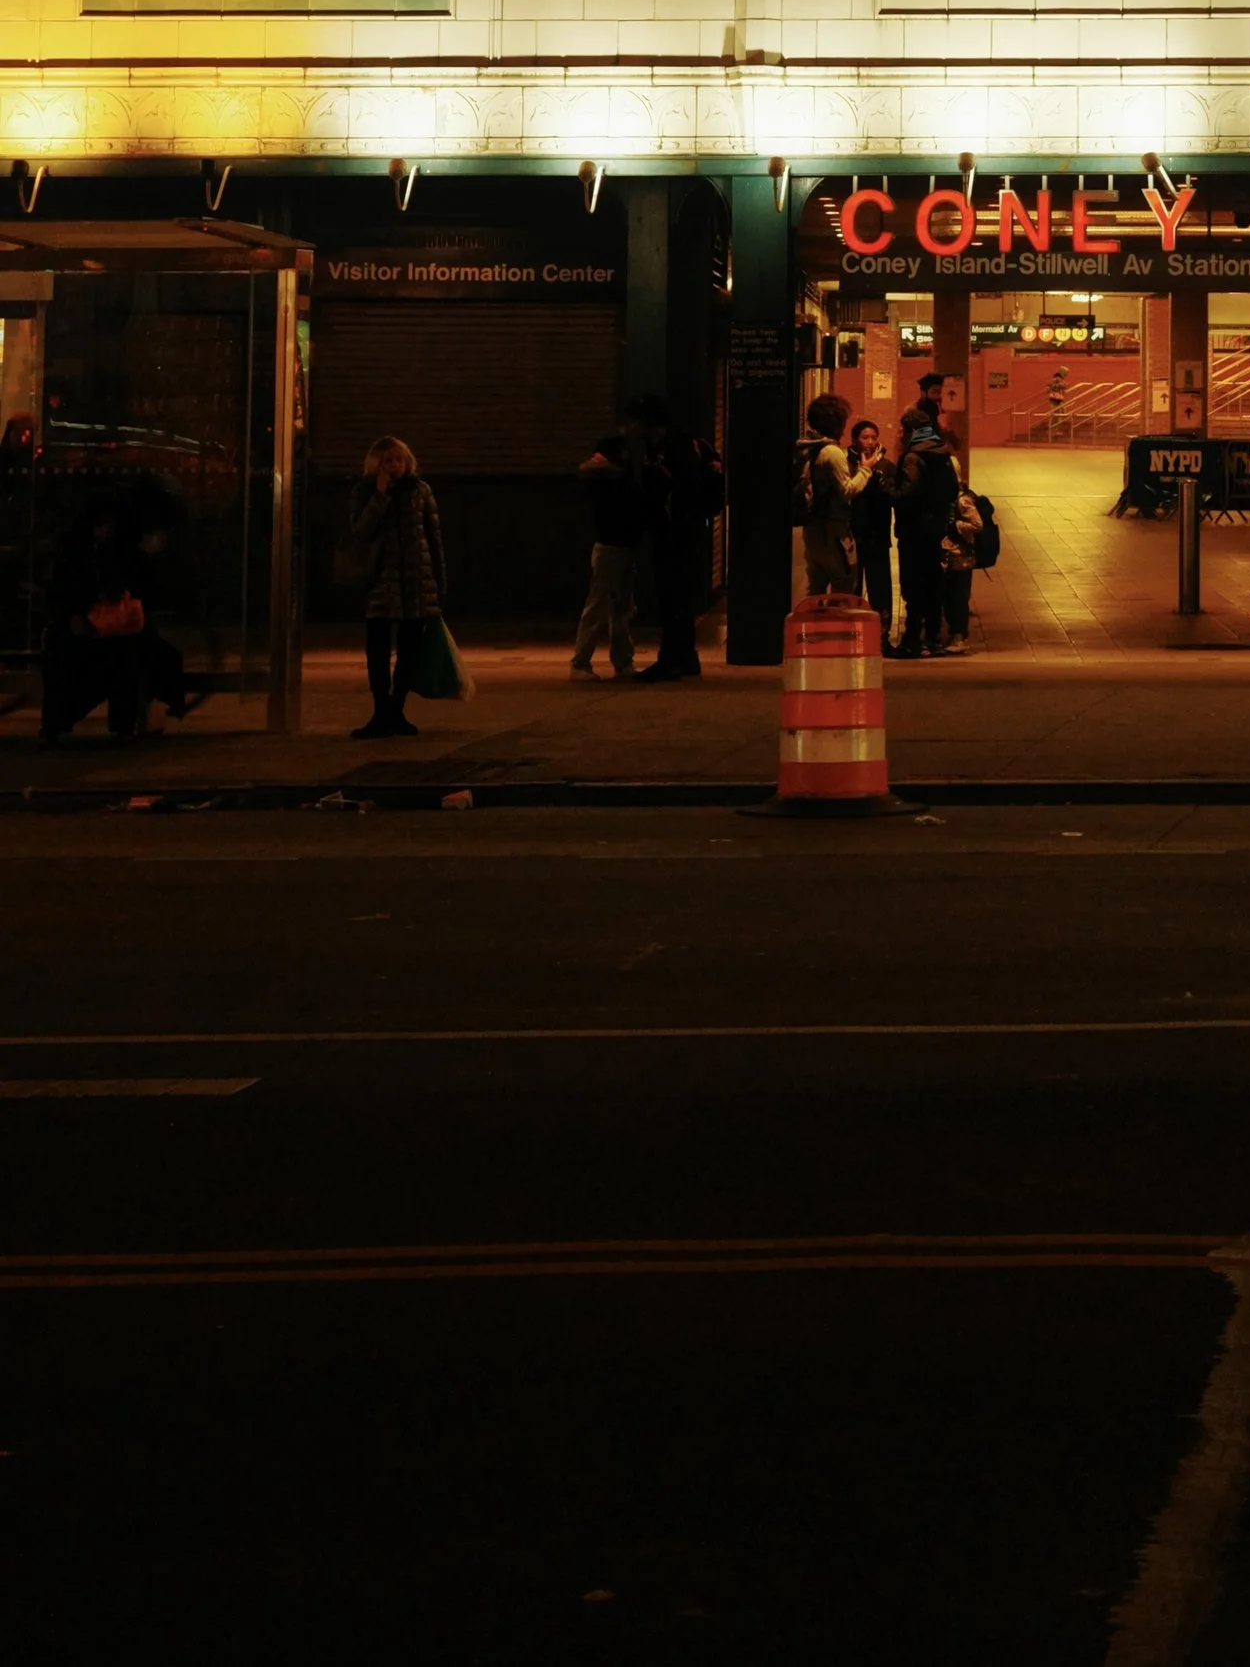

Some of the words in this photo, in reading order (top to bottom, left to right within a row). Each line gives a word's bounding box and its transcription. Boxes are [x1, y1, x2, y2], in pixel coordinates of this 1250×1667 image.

[840, 188, 1197, 255] CONEY
[327, 260, 401, 283] Visitor
[407, 261, 535, 283] Information
[542, 262, 616, 284] Center
[841, 251, 921, 279] Coney
[935, 252, 1109, 276] Island-Stillwell
[1122, 253, 1153, 276] Av
[972, 325, 1004, 334] Mermaid
[1007, 325, 1018, 334] Av
[1149, 450, 1202, 473] NYPD
